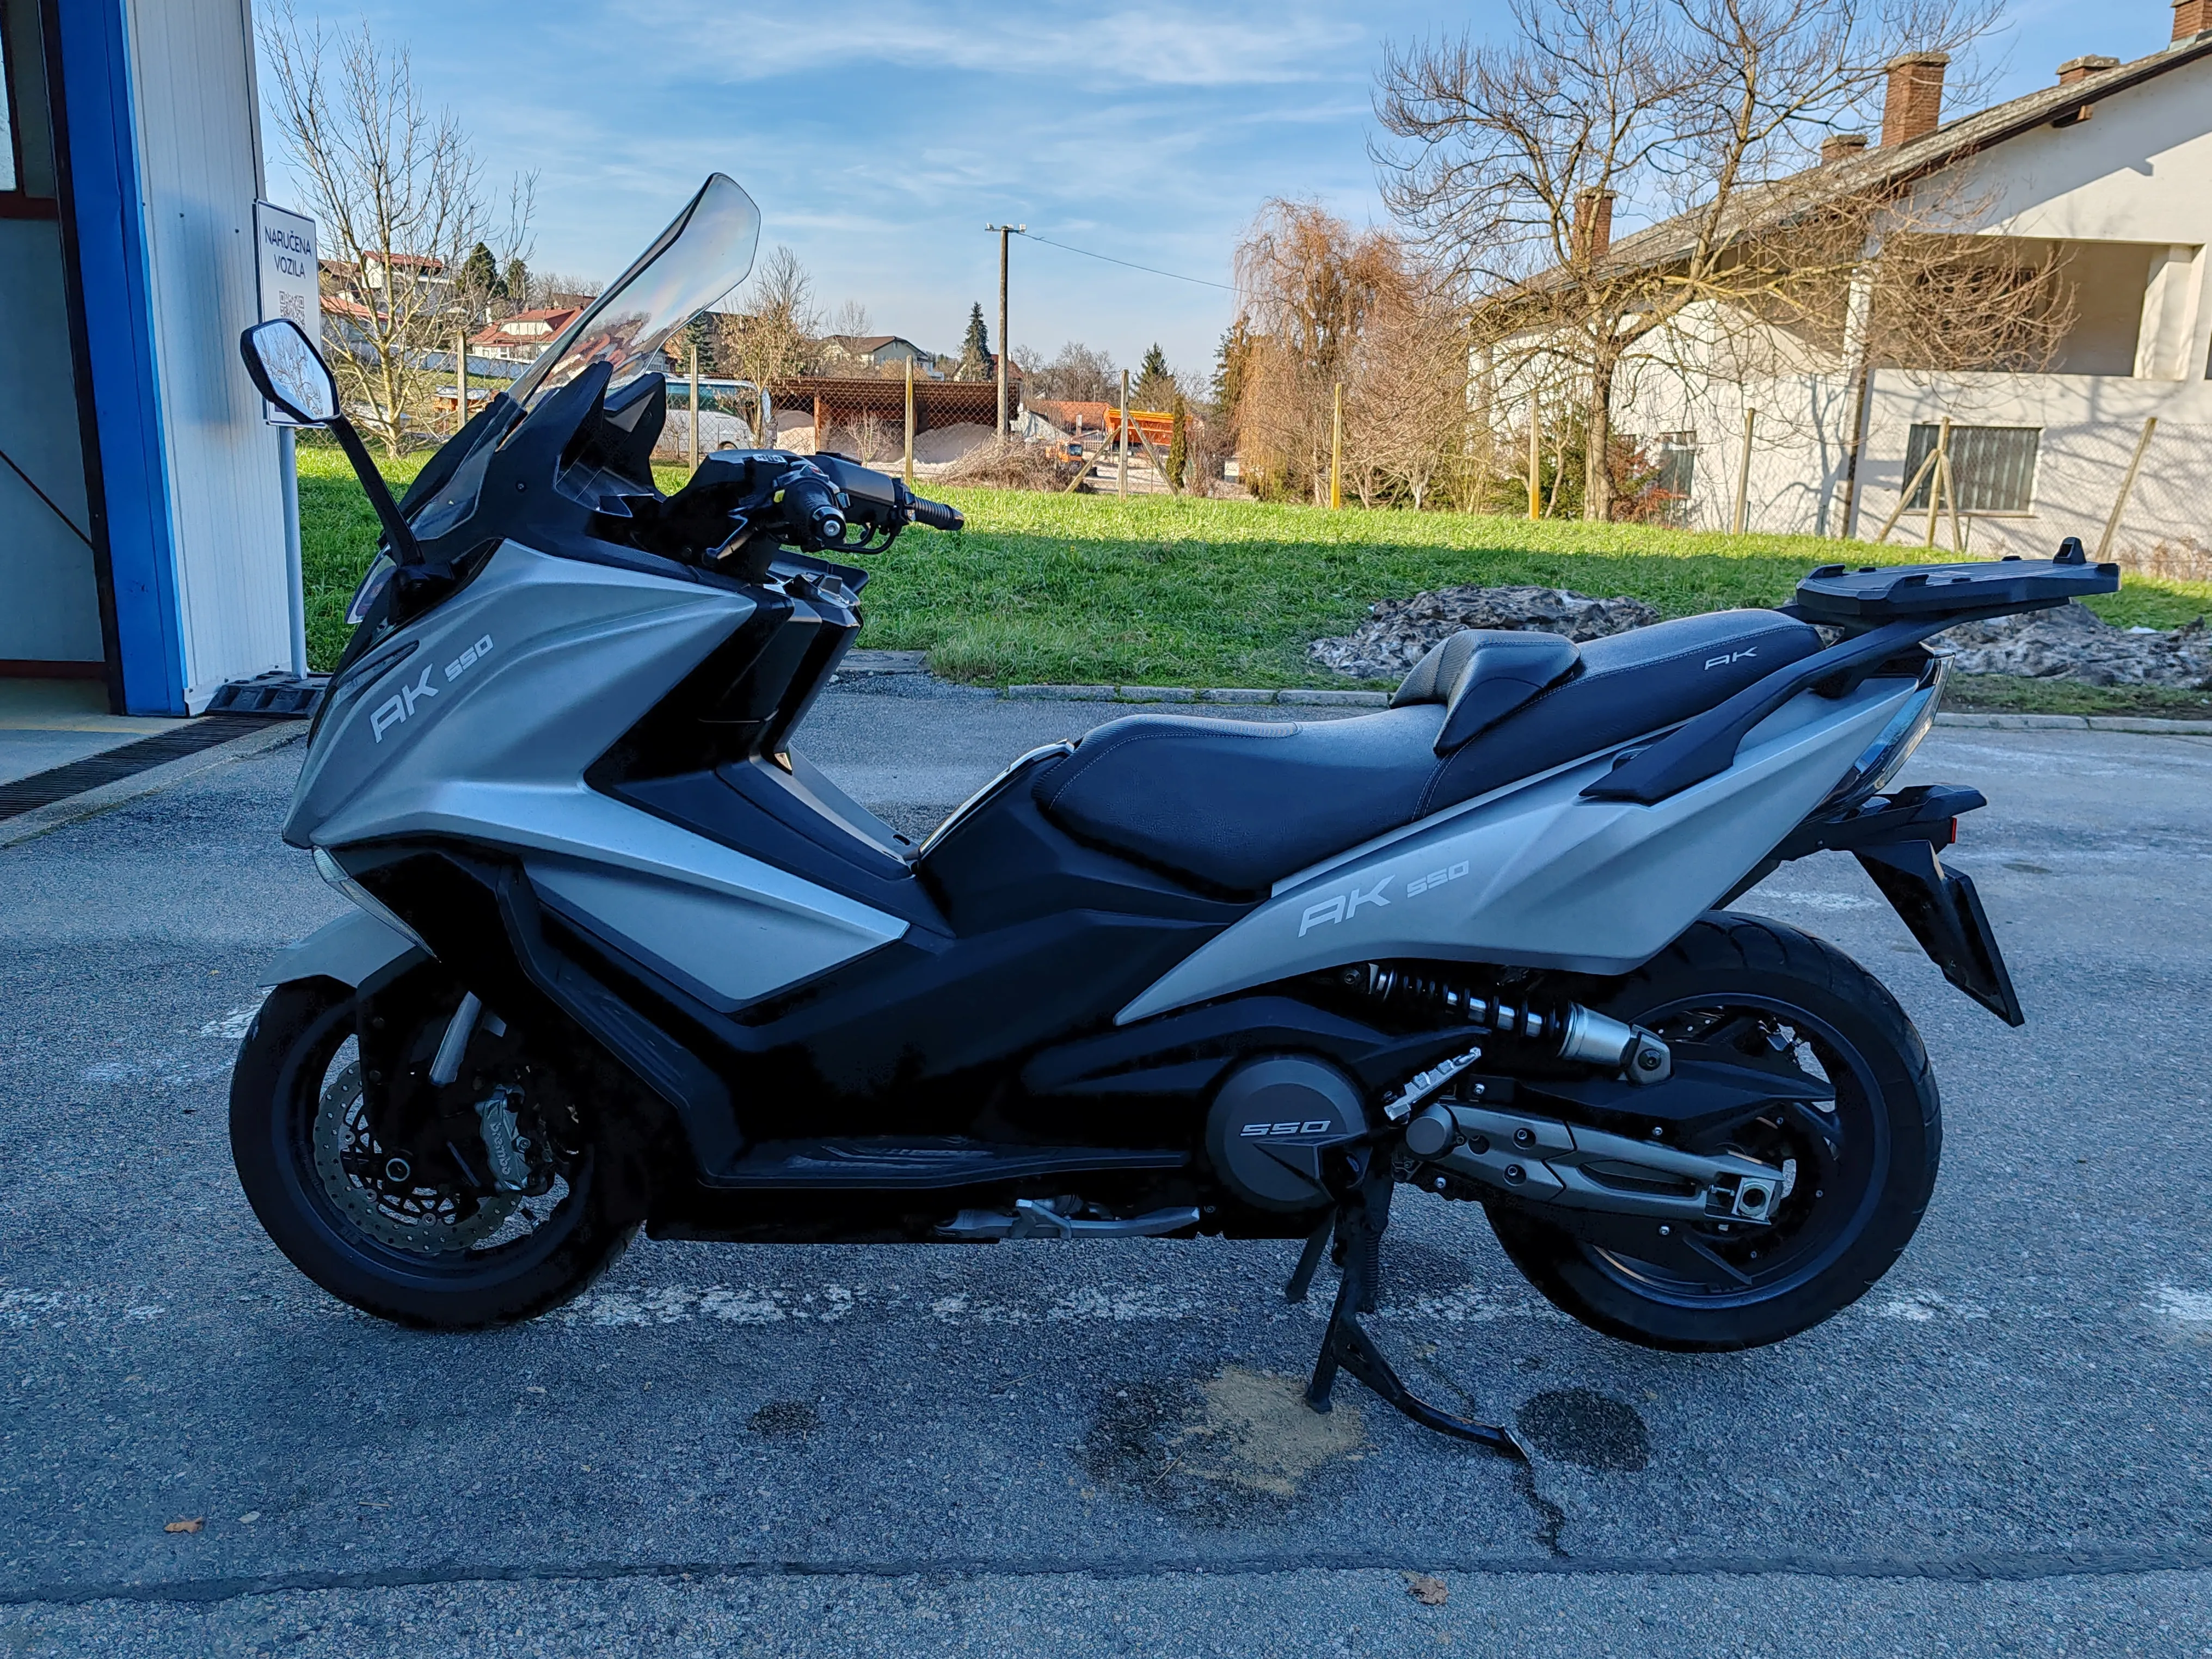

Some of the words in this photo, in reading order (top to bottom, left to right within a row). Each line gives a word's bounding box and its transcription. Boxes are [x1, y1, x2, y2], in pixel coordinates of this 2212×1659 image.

[265, 225, 312, 257] NARUČENA
[274, 254, 306, 279] VOZILA
[1704, 646, 1758, 671] AK
[371, 663, 439, 743] AK
[445, 635, 494, 682] 550
[1298, 874, 1396, 938] AK
[1407, 860, 1469, 898] 550
[1240, 1120, 1331, 1136] 550
[490, 1122, 511, 1175] brembo
